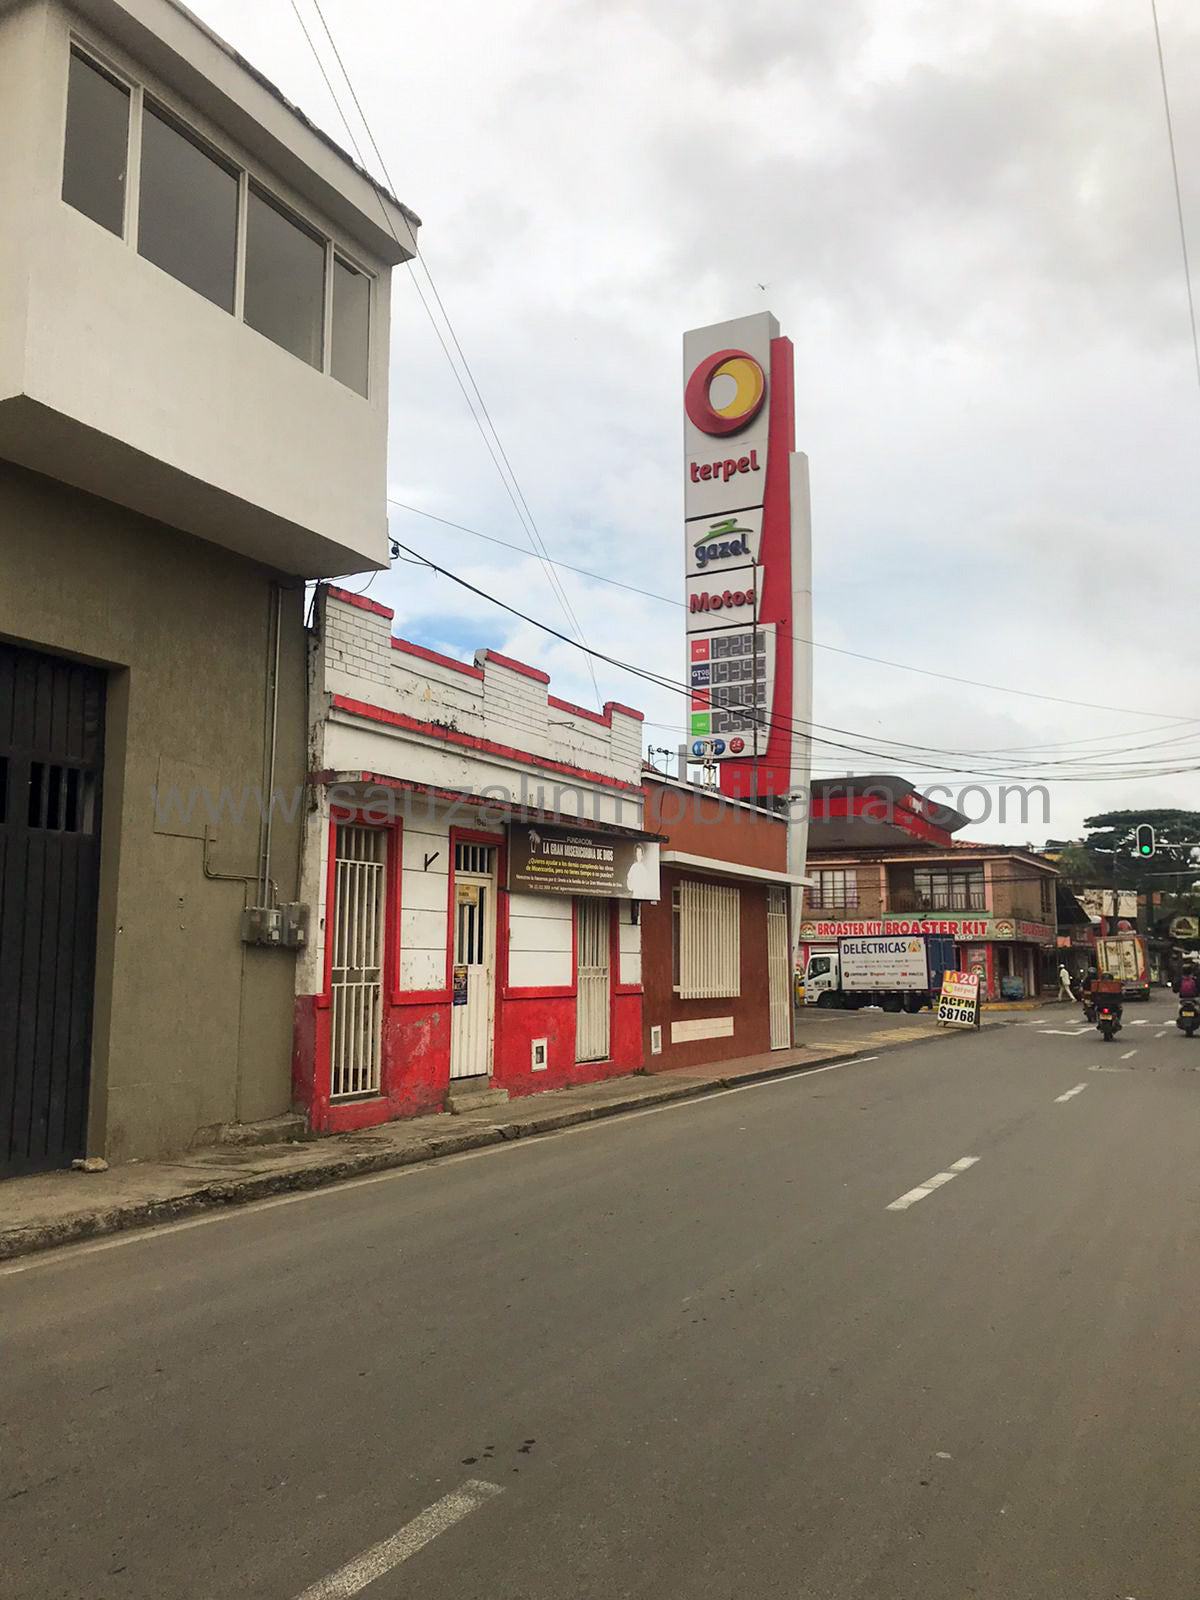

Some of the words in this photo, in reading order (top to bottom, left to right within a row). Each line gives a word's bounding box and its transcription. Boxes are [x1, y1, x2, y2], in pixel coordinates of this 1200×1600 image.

[690, 449, 760, 482] terpel
[695, 533, 751, 569] gazel
[689, 589, 756, 614] Motos
[542, 842, 549, 854] LA
[550, 843, 564, 856] GRAN
[564, 844, 596, 860] MISERICORDIA
[596, 848, 603, 861] DE
[603, 849, 614, 862] DIOS
[816, 921, 865, 936] BROASTER
[866, 921, 882, 936] KIT
[885, 920, 960, 936] BROASTER
[961, 920, 988, 936] KIT
[959, 973, 978, 985] 20
[941, 996, 975, 1008] ACPM
[939, 1005, 974, 1023] $8768
